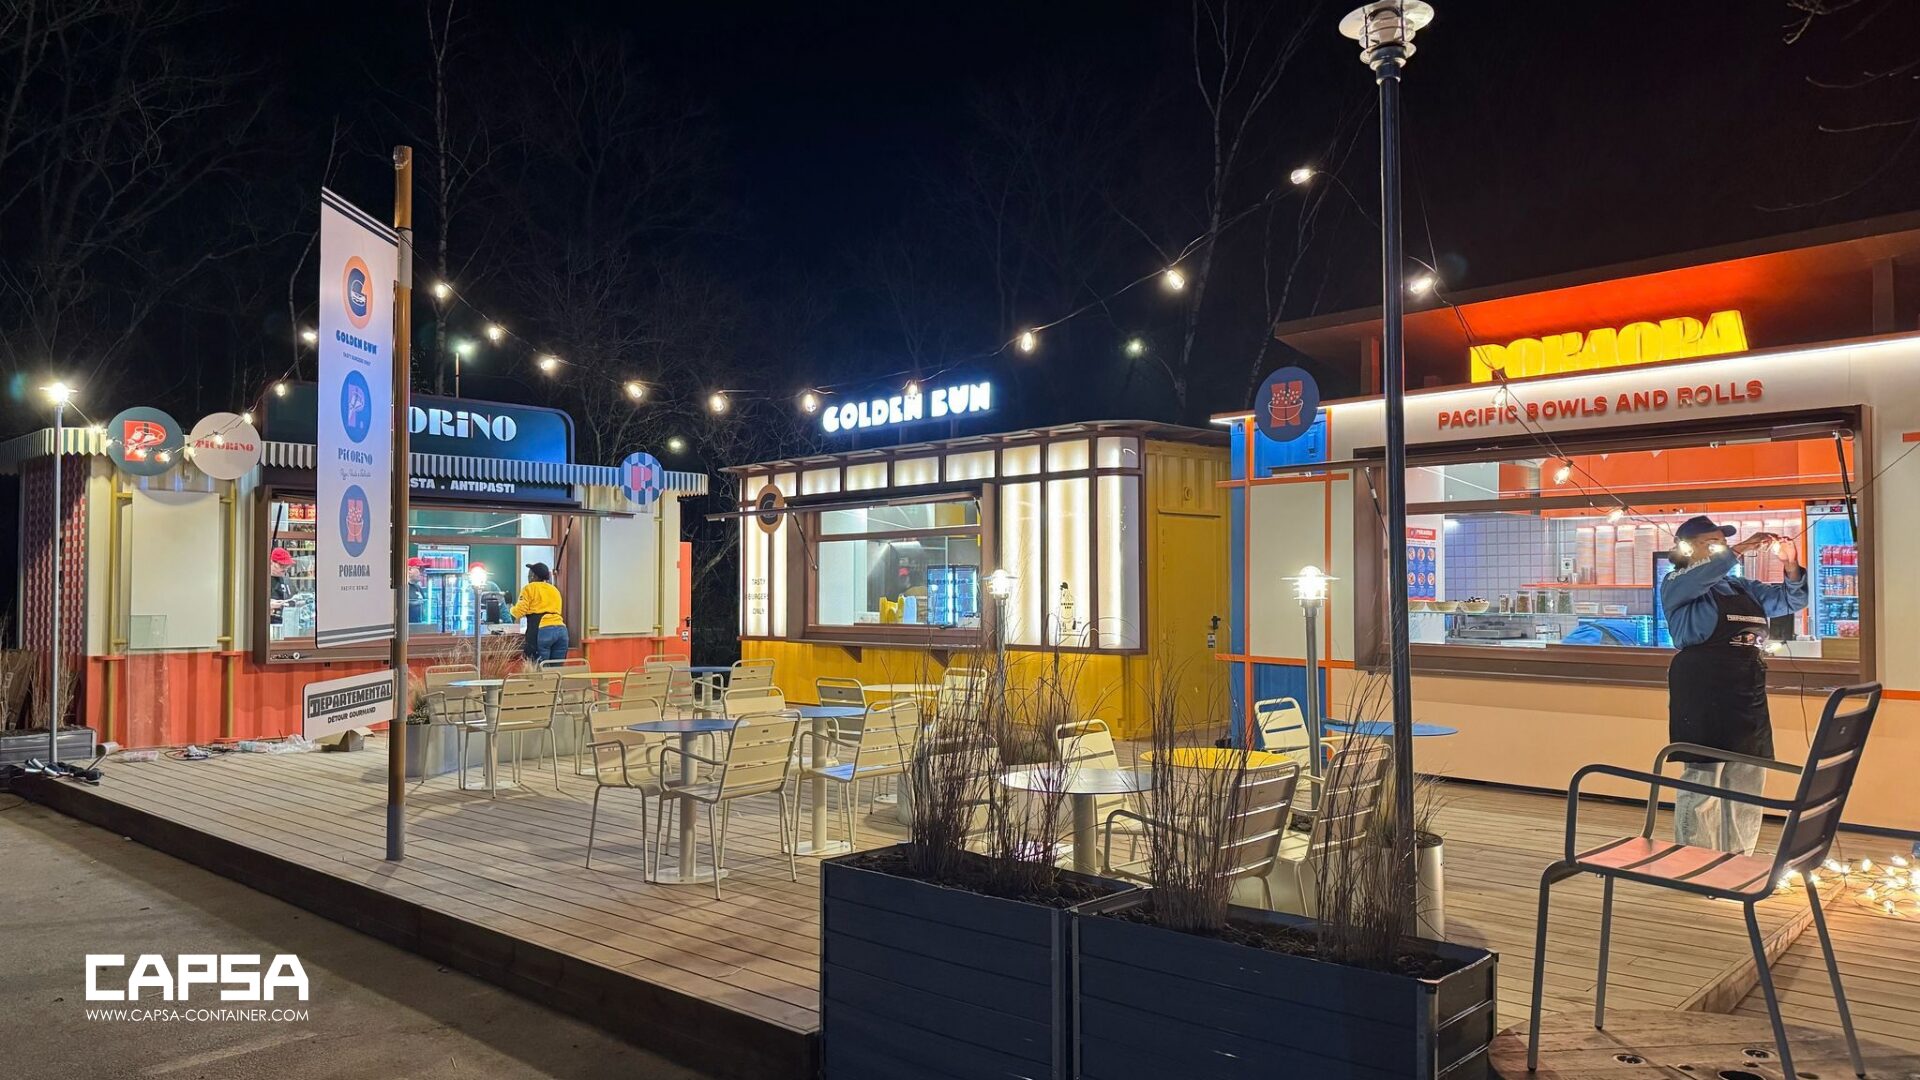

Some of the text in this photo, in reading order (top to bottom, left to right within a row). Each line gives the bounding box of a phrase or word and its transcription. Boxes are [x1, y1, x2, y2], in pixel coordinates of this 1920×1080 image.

[335, 329, 377, 355] GOLDEN BUN
[1469, 309, 1749, 384] POKAORA
[822, 382, 991, 433] GOLDEN BUN
[1438, 380, 1763, 430] PACIFIC BOWLS AND ROLLS
[450, 479, 515, 494] ANTIPASTI
[349, 706, 377, 719] GOURMAND
